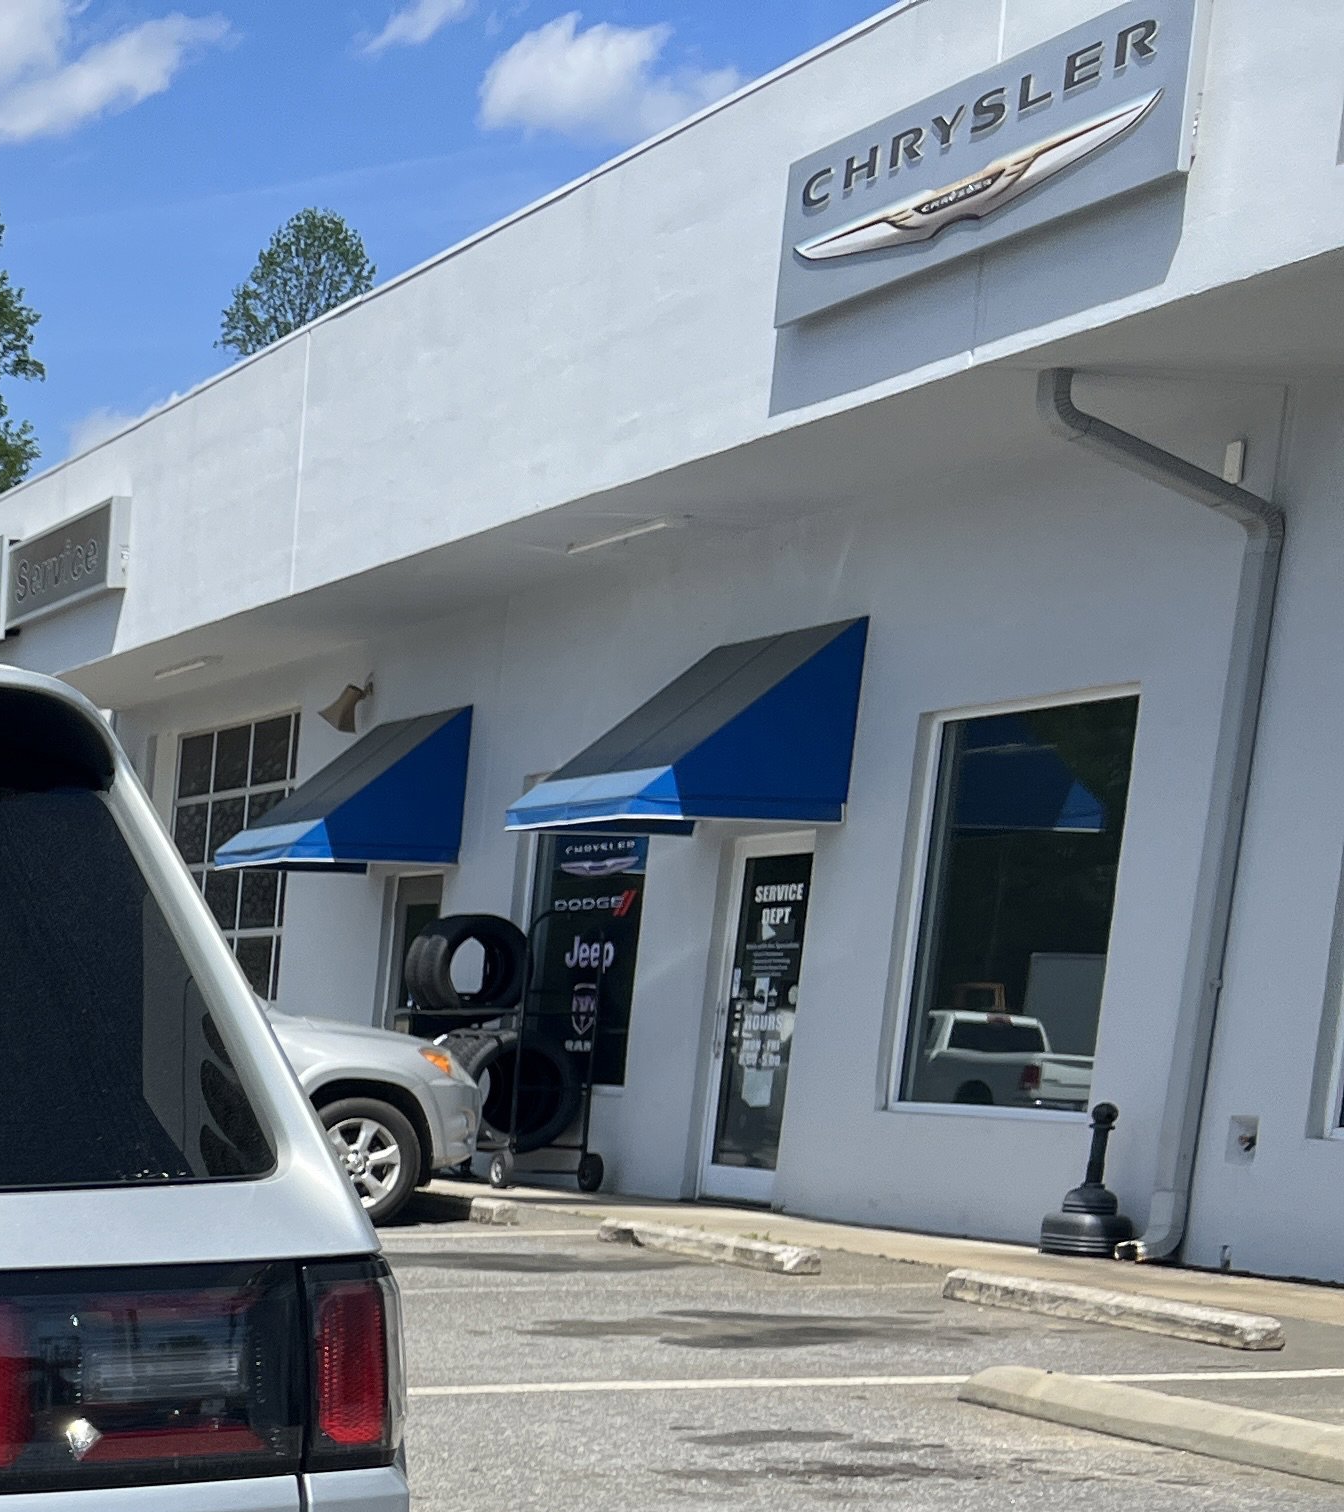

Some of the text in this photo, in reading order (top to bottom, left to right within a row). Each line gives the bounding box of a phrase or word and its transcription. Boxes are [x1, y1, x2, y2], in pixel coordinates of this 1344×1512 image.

[802, 19, 1159, 208] CHRYSLER
[15, 538, 100, 604] Service
[754, 882, 805, 903] SERVICE
[761, 906, 792, 925] DEPT
[565, 935, 614, 973] Jeep
[742, 1013, 783, 1031] HOURS
